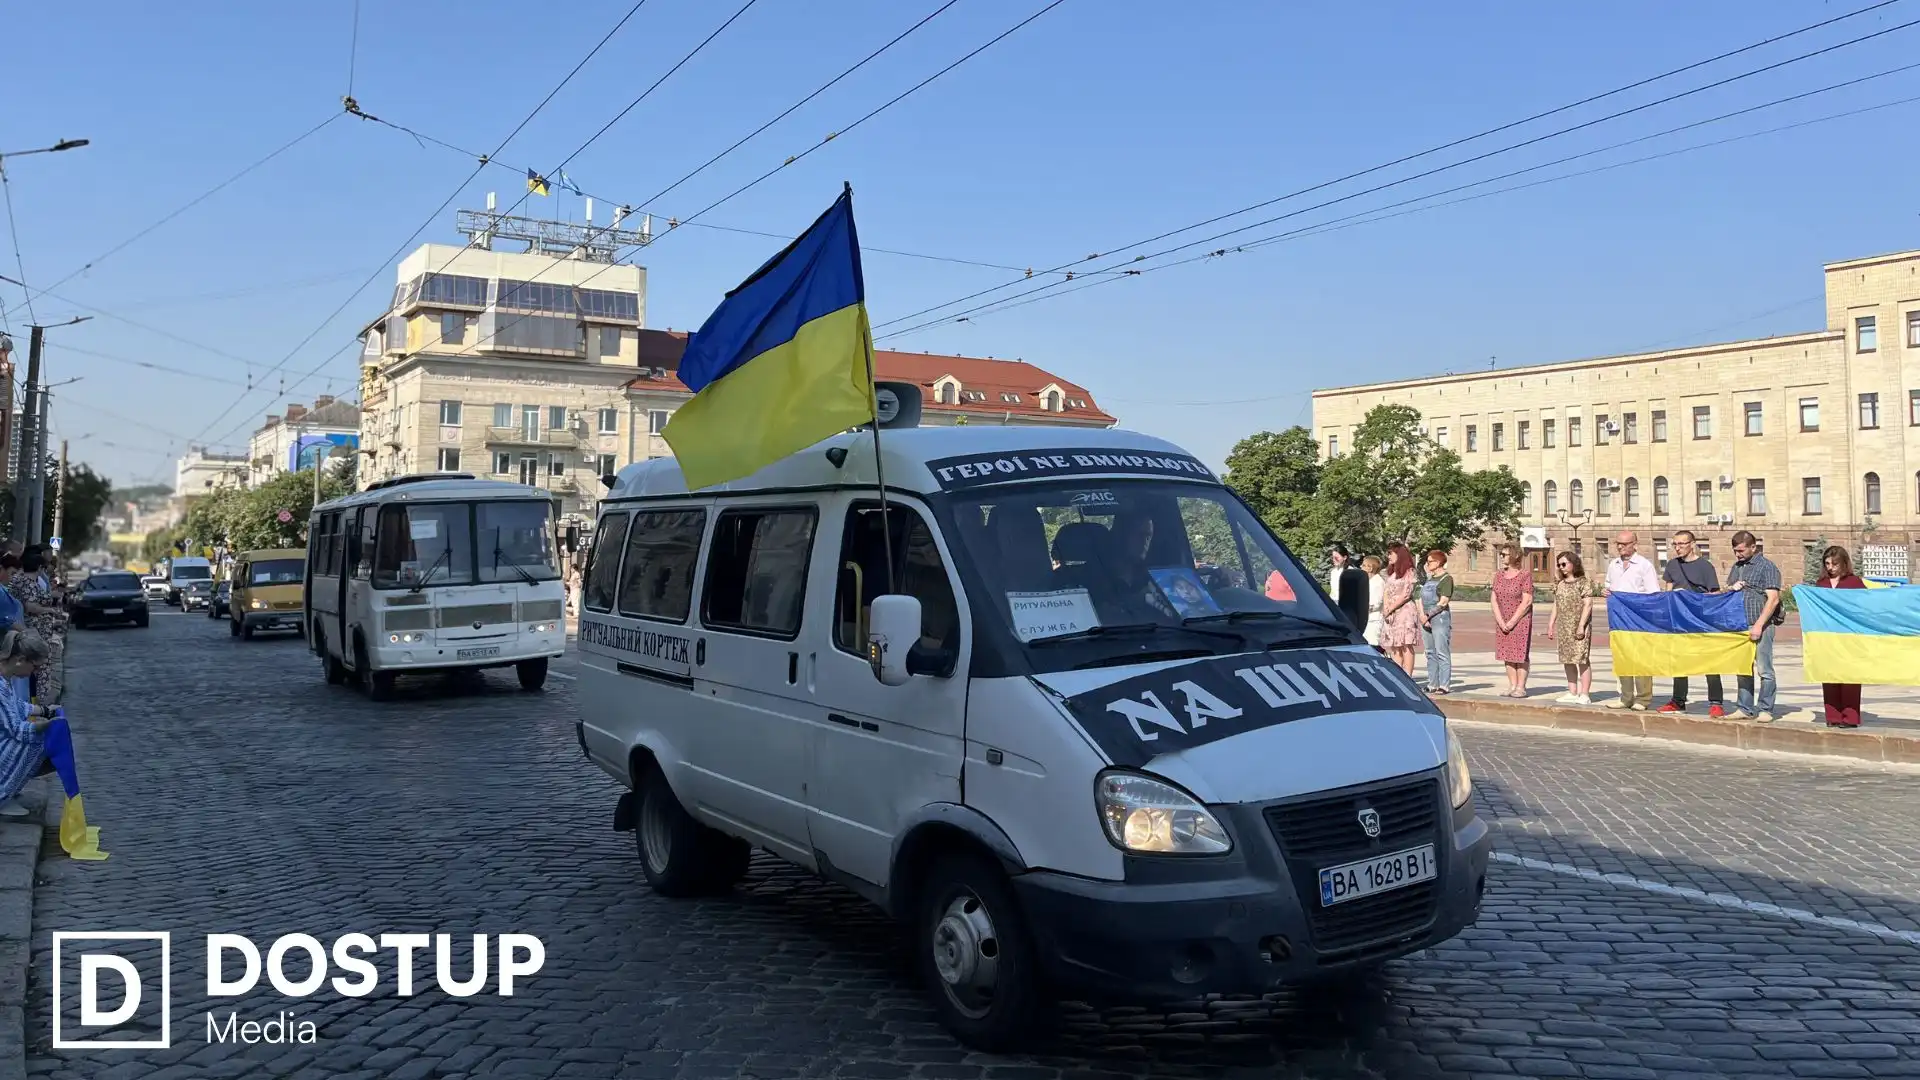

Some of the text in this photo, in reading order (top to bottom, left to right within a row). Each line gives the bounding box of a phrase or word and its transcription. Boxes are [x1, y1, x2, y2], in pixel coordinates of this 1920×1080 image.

[937, 456, 1028, 482] ГЕРОЇ
[1072, 454, 1209, 475] ВМИРАЮТЬ
[1013, 599, 1074, 611] РИТУАЛЬНА
[581, 619, 690, 665] РИТУАЛЬНИЙ КОРТЕЖ
[1020, 621, 1078, 636] СЛУЖБА
[1234, 659, 1422, 709] ЩИТІ
[1332, 851, 1427, 897] BA 1628 BI
